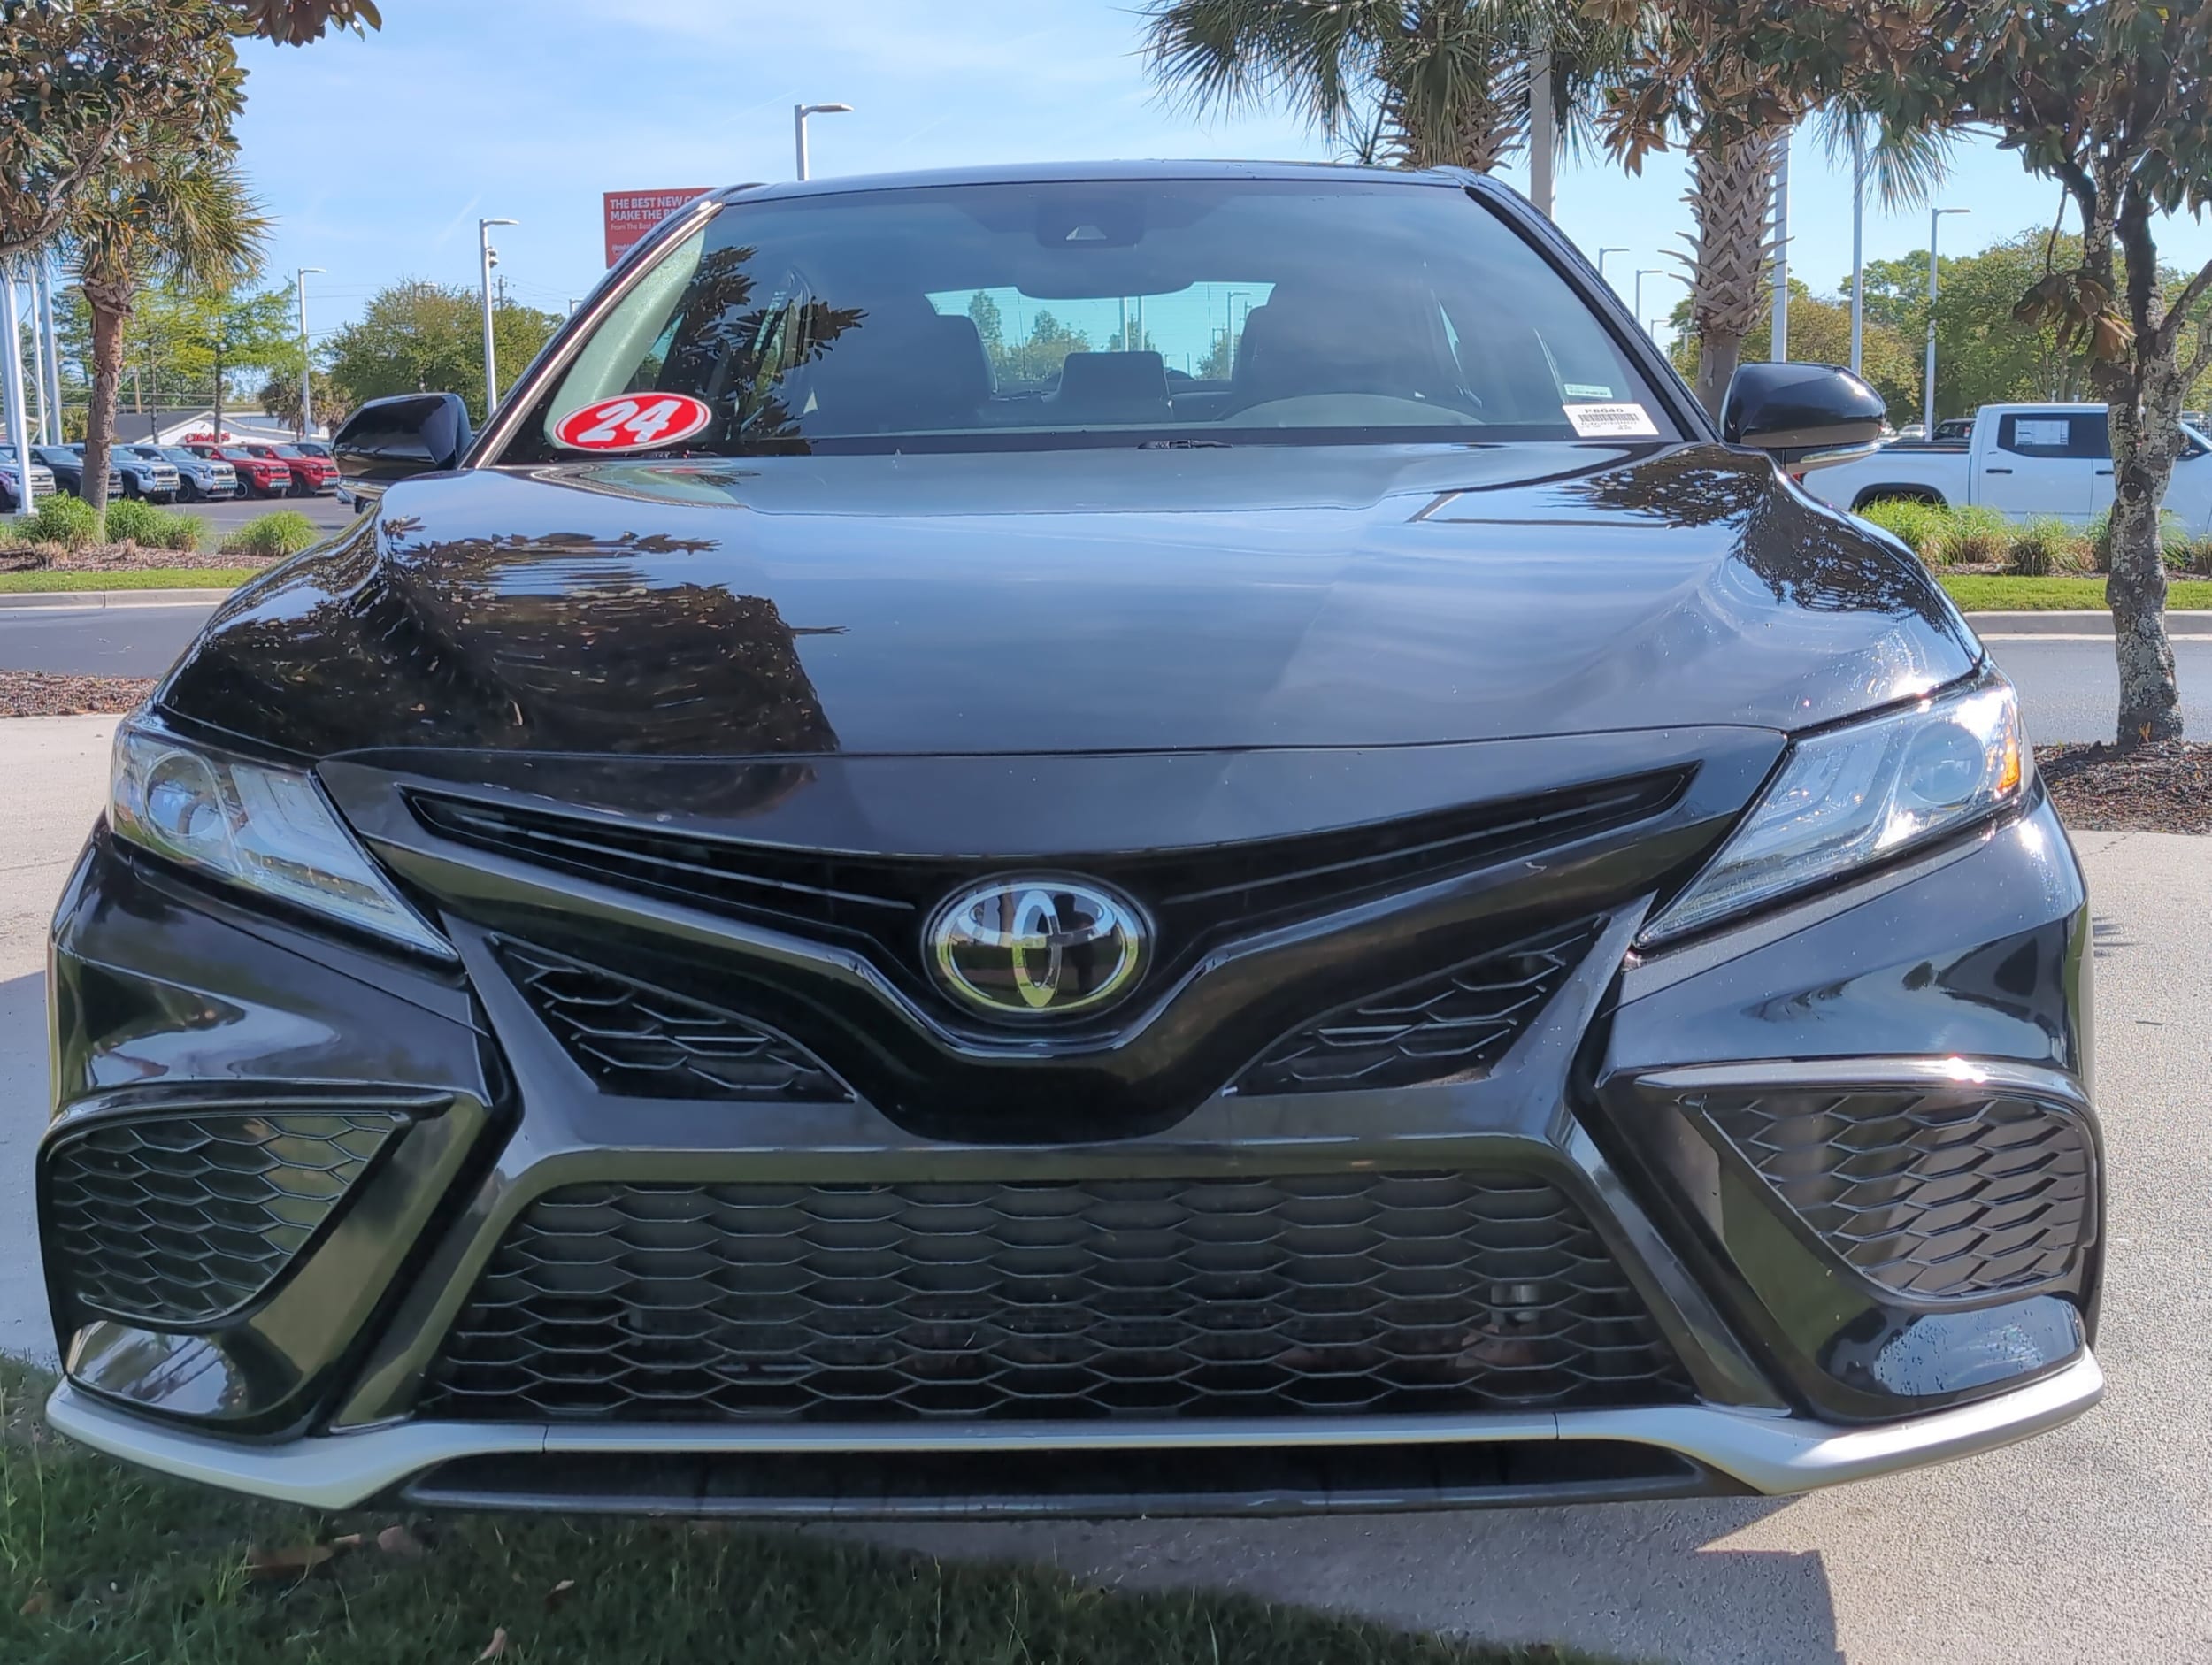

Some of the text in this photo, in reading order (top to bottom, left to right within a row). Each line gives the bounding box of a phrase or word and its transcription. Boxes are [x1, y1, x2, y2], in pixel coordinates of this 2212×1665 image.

[610, 198, 630, 210] THE
[631, 197, 657, 209] BEST
[657, 196, 682, 208] NEW
[611, 210, 641, 221] MAKE
[642, 210, 663, 220] THE
[576, 399, 684, 443] 24
